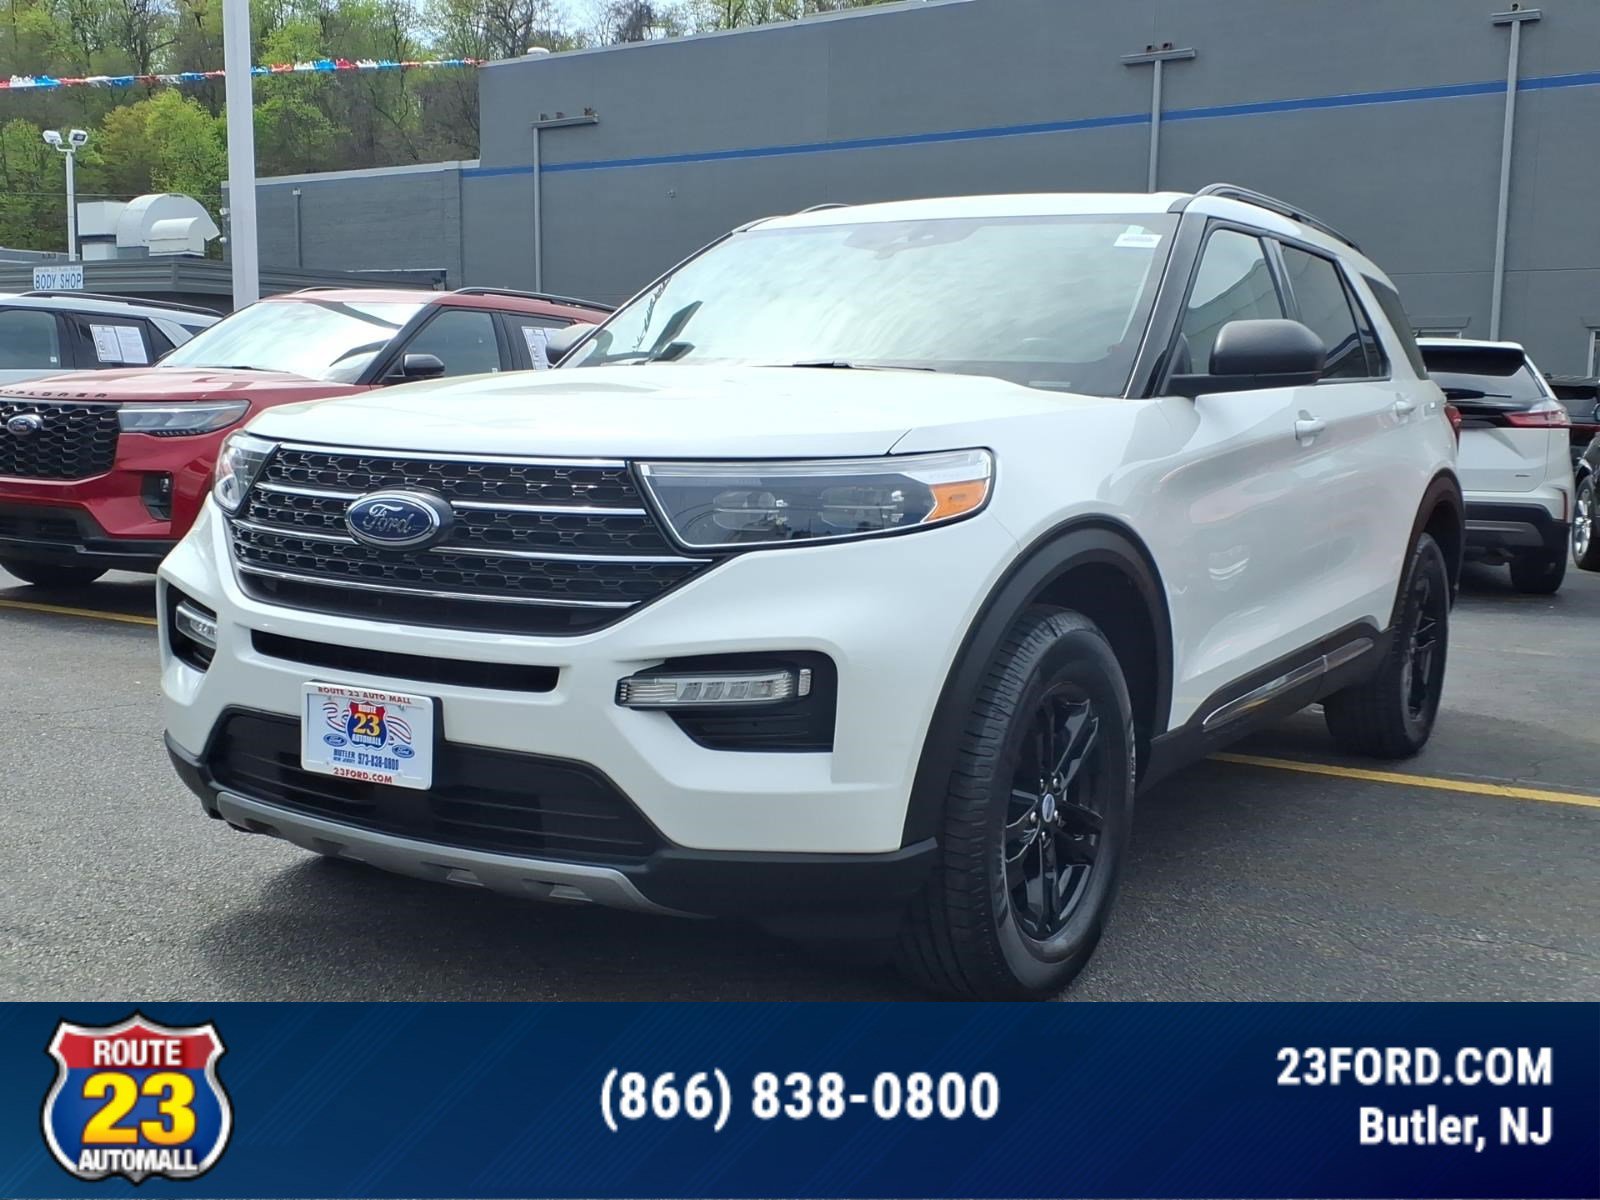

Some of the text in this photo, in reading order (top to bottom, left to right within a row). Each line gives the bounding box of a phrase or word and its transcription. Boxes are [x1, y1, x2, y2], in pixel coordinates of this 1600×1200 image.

[35, 272, 82, 289] BODY SHOP
[362, 503, 415, 534] Ford
[318, 686, 345, 696] ROUTE
[363, 691, 386, 701] AUTO
[389, 695, 412, 705] MALL
[353, 713, 381, 737] 23
[333, 748, 356, 759] BUTLER
[333, 767, 393, 784] 23FORD.COM
